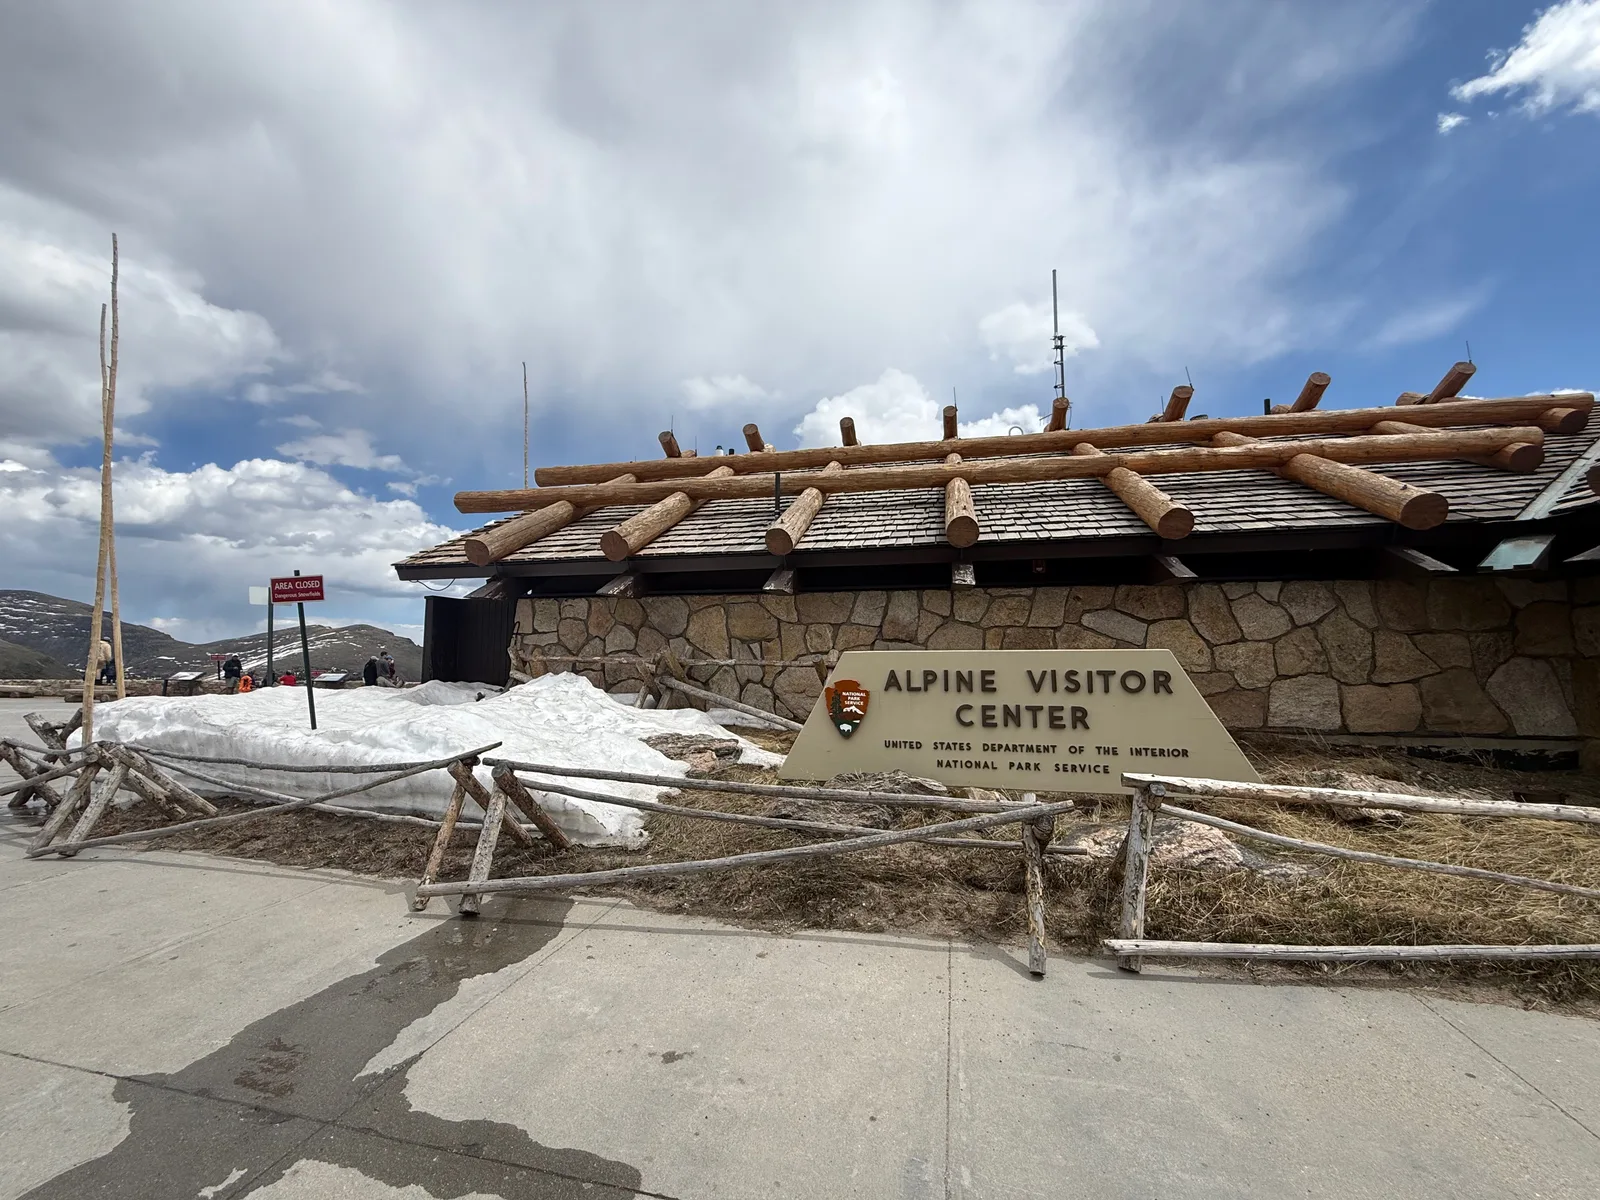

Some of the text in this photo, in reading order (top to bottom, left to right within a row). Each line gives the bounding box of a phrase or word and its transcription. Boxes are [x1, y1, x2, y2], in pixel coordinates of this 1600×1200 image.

[274, 580, 320, 590] AREA CLOSED
[883, 669, 1174, 696] ALPINE VISITOR
[955, 703, 1091, 731] CENTER
[884, 739, 1190, 759] UNITED STATES DEPARTMENT OF THE INTERIOR
[936, 759, 1111, 775] NATIONAL PARK SERVICE
